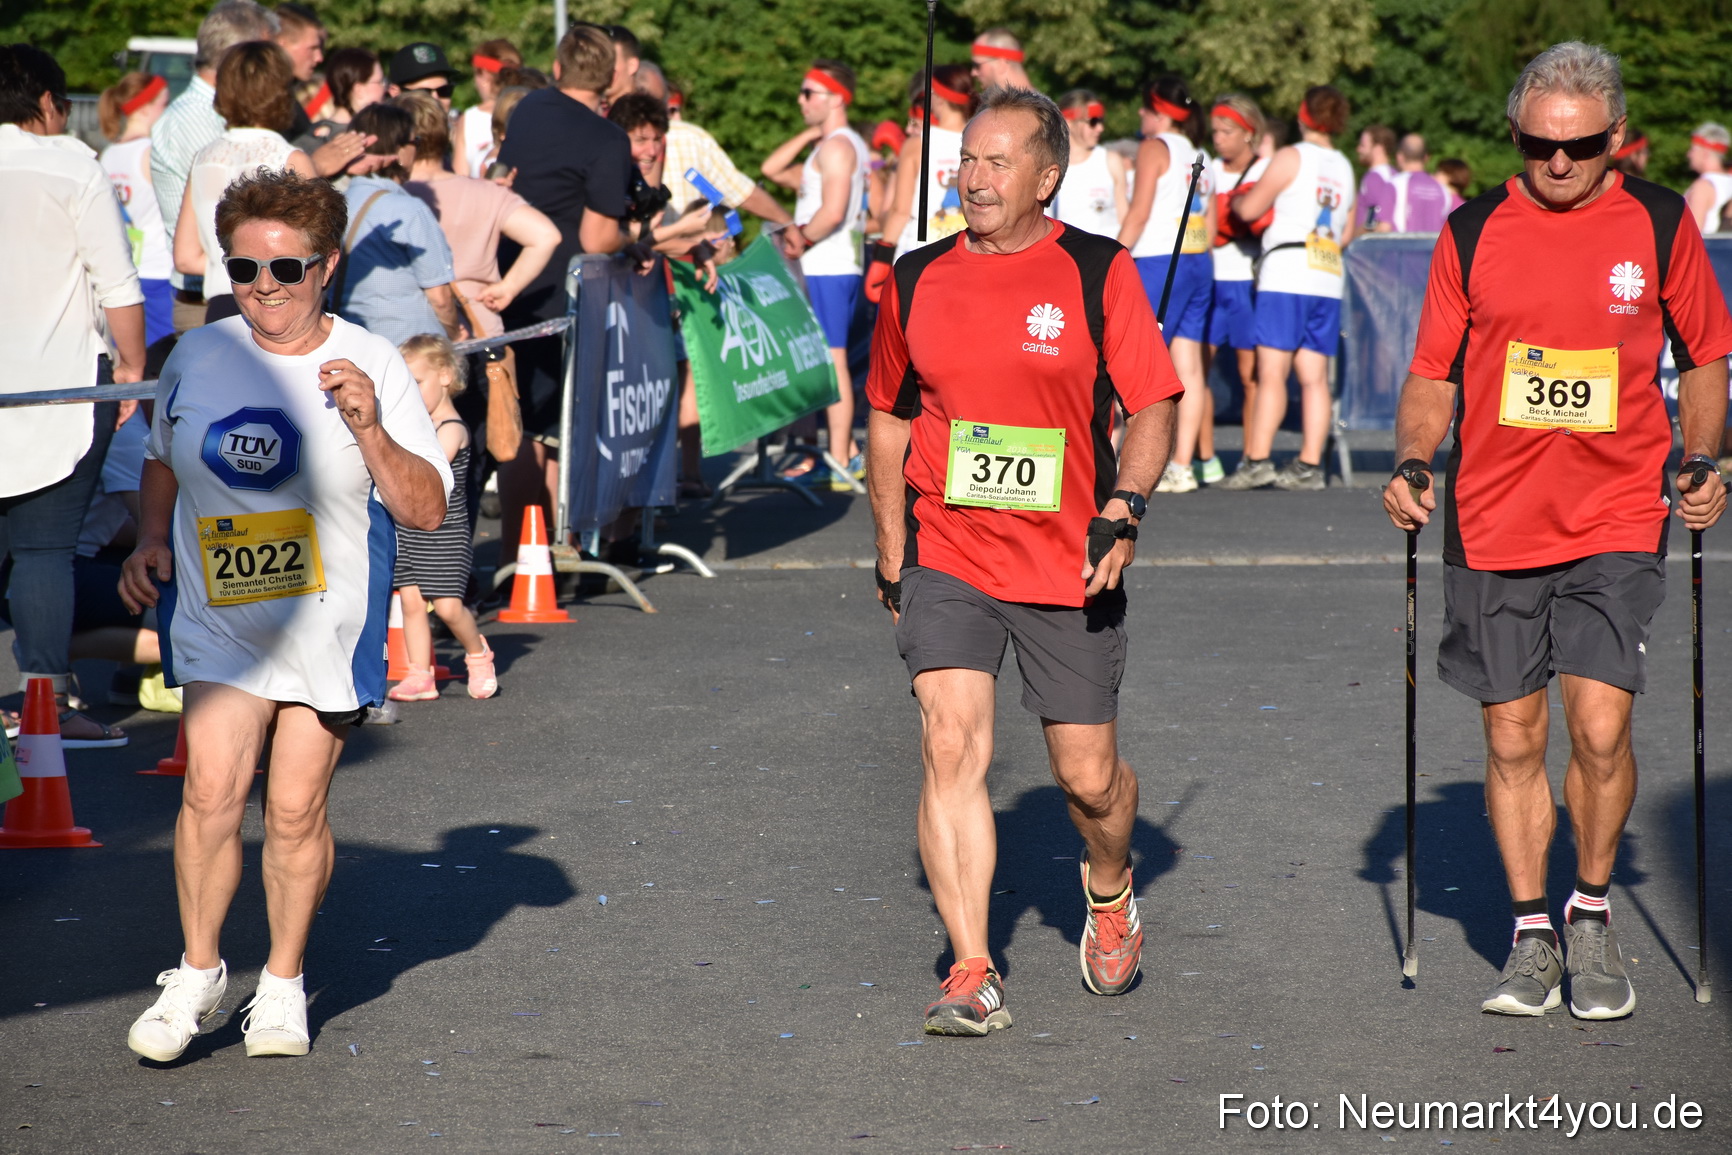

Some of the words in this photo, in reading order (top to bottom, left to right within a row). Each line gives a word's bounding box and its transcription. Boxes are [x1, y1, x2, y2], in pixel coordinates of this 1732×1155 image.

[1609, 303, 1639, 315] caritas
[1022, 341, 1060, 356] caritas
[1519, 357, 1557, 369] firmenlauf
[1526, 377, 1591, 409] 369
[606, 363, 671, 439] Fischer
[1529, 406, 1551, 416] Beck
[1553, 409, 1587, 418] Michael
[1520, 414, 1581, 424] Caritas-Sozialstation
[229, 433, 278, 457] TÜV
[964, 434, 1003, 446] firmenlauf
[237, 459, 262, 472] SÜD
[971, 453, 1036, 487] 370
[969, 483, 1003, 495] Diepold
[1004, 487, 1037, 496] Johann
[966, 491, 1025, 502] Caritas-Sozialstation
[211, 528, 249, 538] firmenlauf
[213, 541, 305, 580] 2022
[222, 577, 266, 589] Siemantel
[268, 573, 302, 584] Christa
[219, 589, 231, 597] TÜV
[232, 588, 246, 596] SÜD
[263, 584, 287, 592] Service
[287, 580, 308, 589] GmbH
